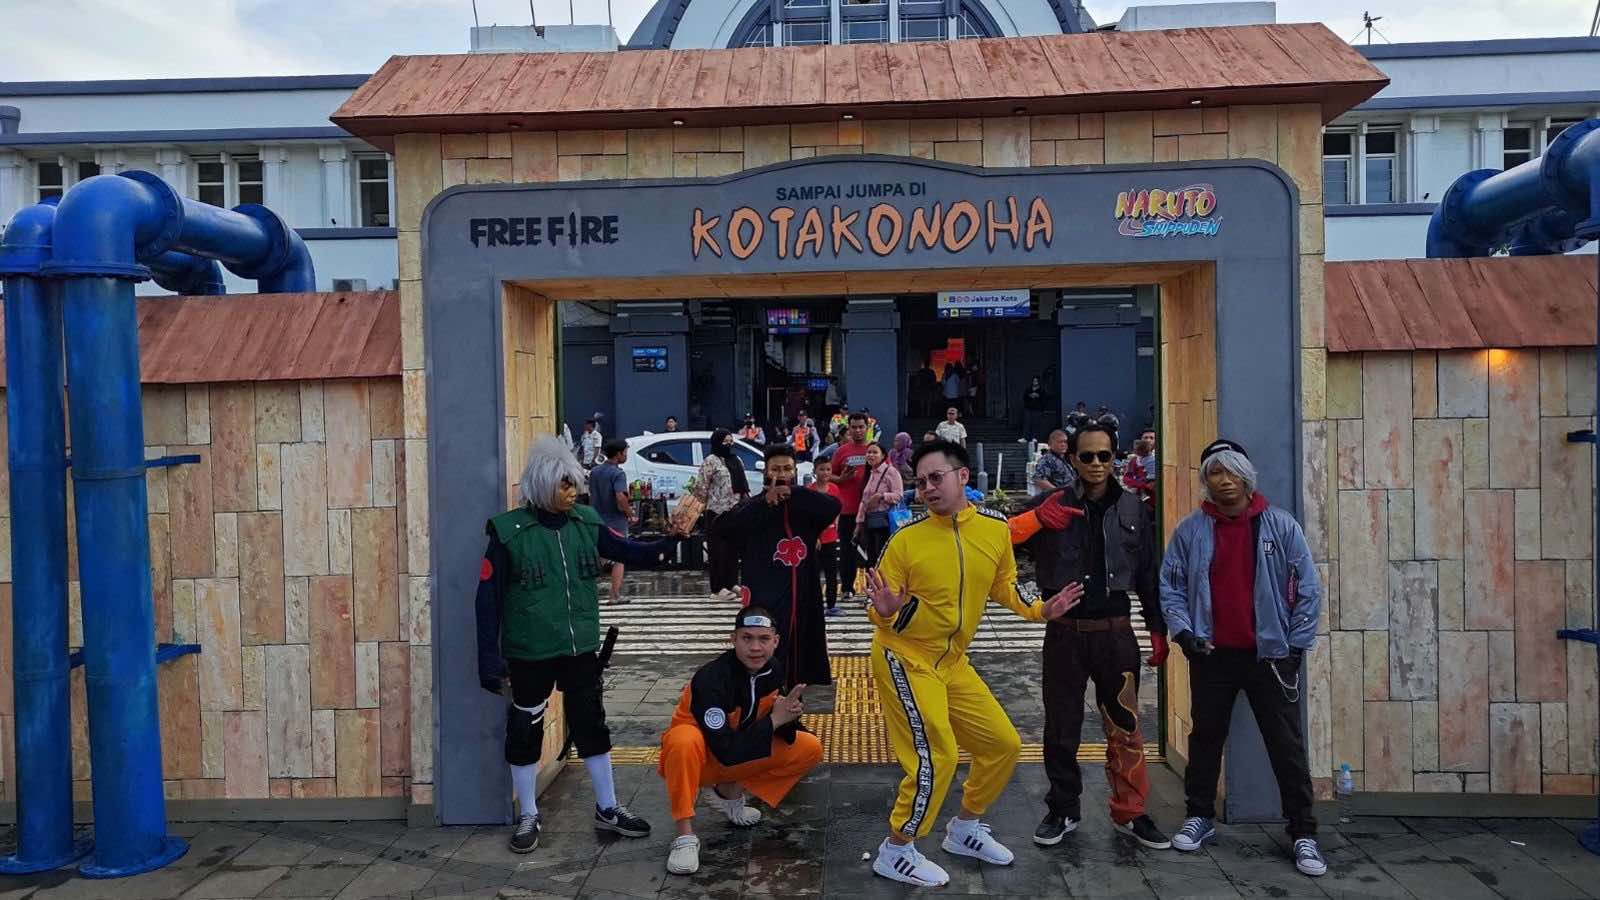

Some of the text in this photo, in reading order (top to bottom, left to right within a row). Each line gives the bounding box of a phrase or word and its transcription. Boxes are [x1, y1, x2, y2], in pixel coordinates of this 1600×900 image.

[776, 182, 926, 201] SAMPAI JUMPA DI
[1115, 188, 1216, 220] NARUTO
[470, 211, 619, 248] FREE FIRE
[692, 197, 1053, 260] KOTAKONOHA
[1142, 216, 1223, 237] SHIPPUDEN
[971, 294, 1018, 303] Jakarta Kota
